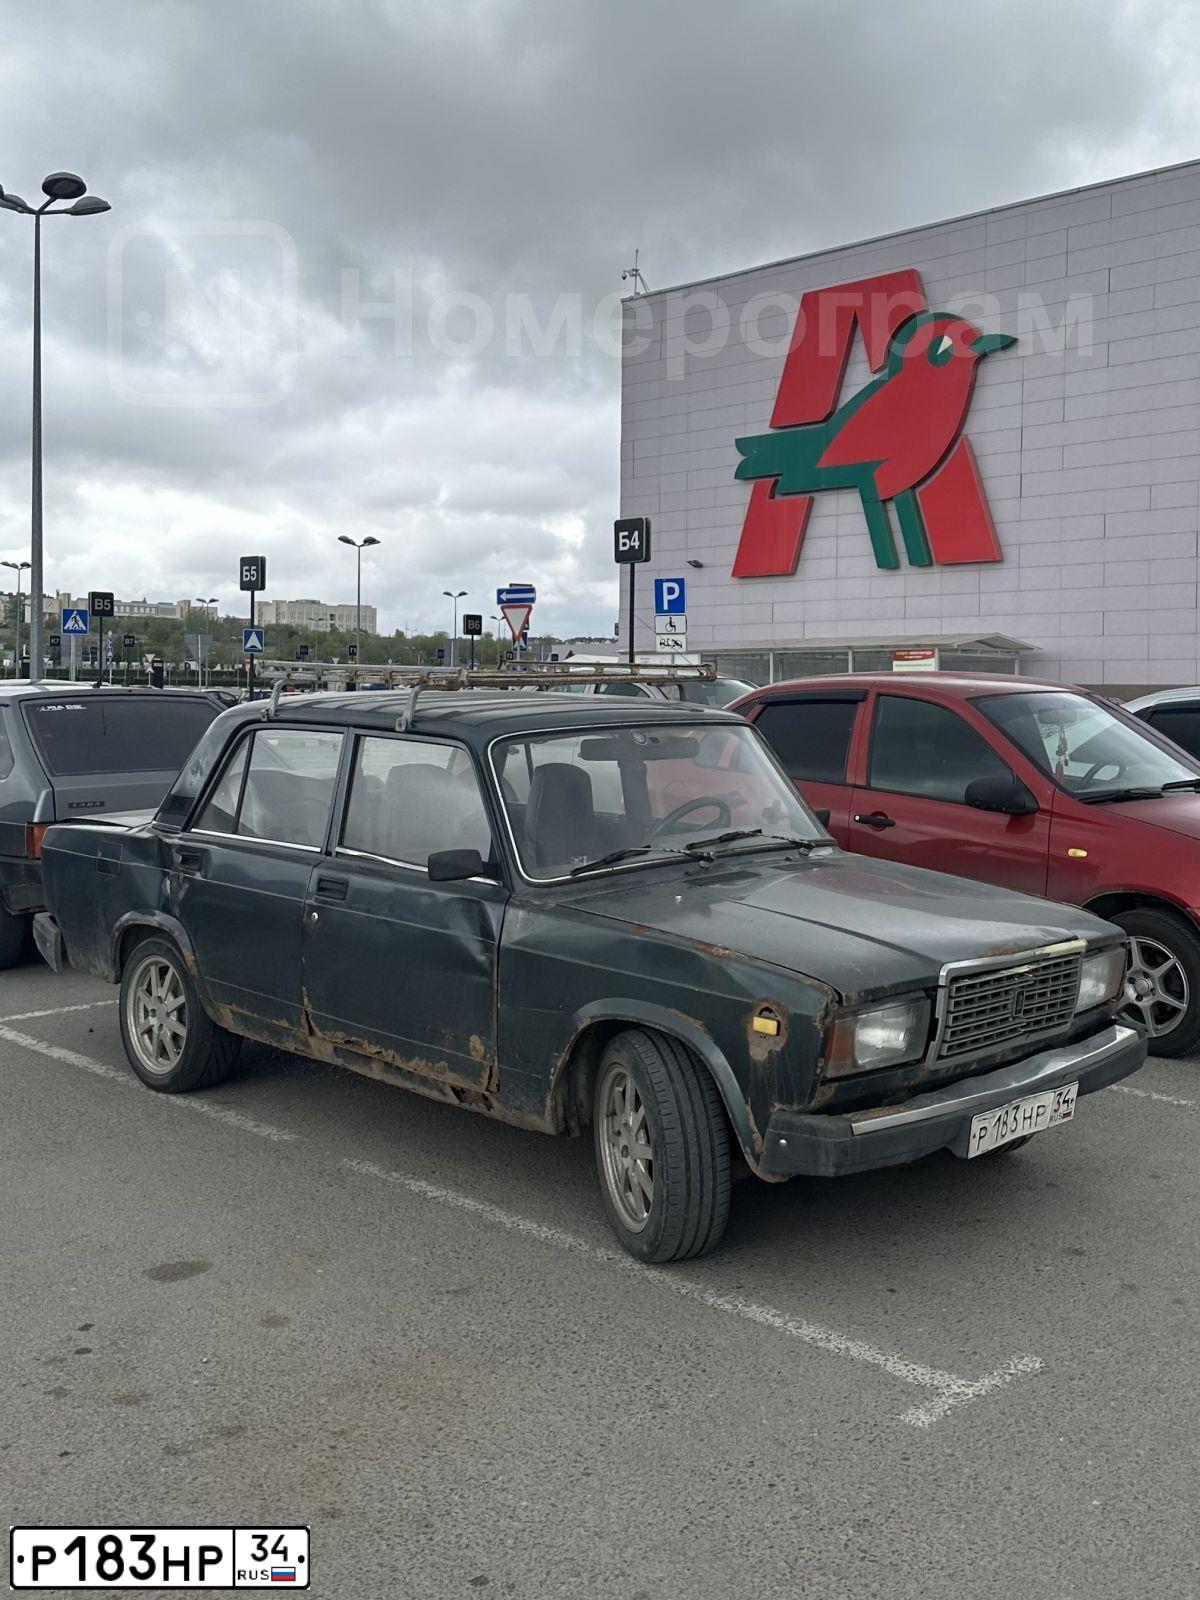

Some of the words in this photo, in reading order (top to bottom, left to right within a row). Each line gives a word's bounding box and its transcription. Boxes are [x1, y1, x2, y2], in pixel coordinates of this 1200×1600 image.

[619, 530, 640, 551] Б4
[242, 565, 257, 582] Б5
[662, 581, 681, 611] P
[976, 1103, 1047, 1151] Р183НР
[1053, 1088, 1071, 1113] 34
